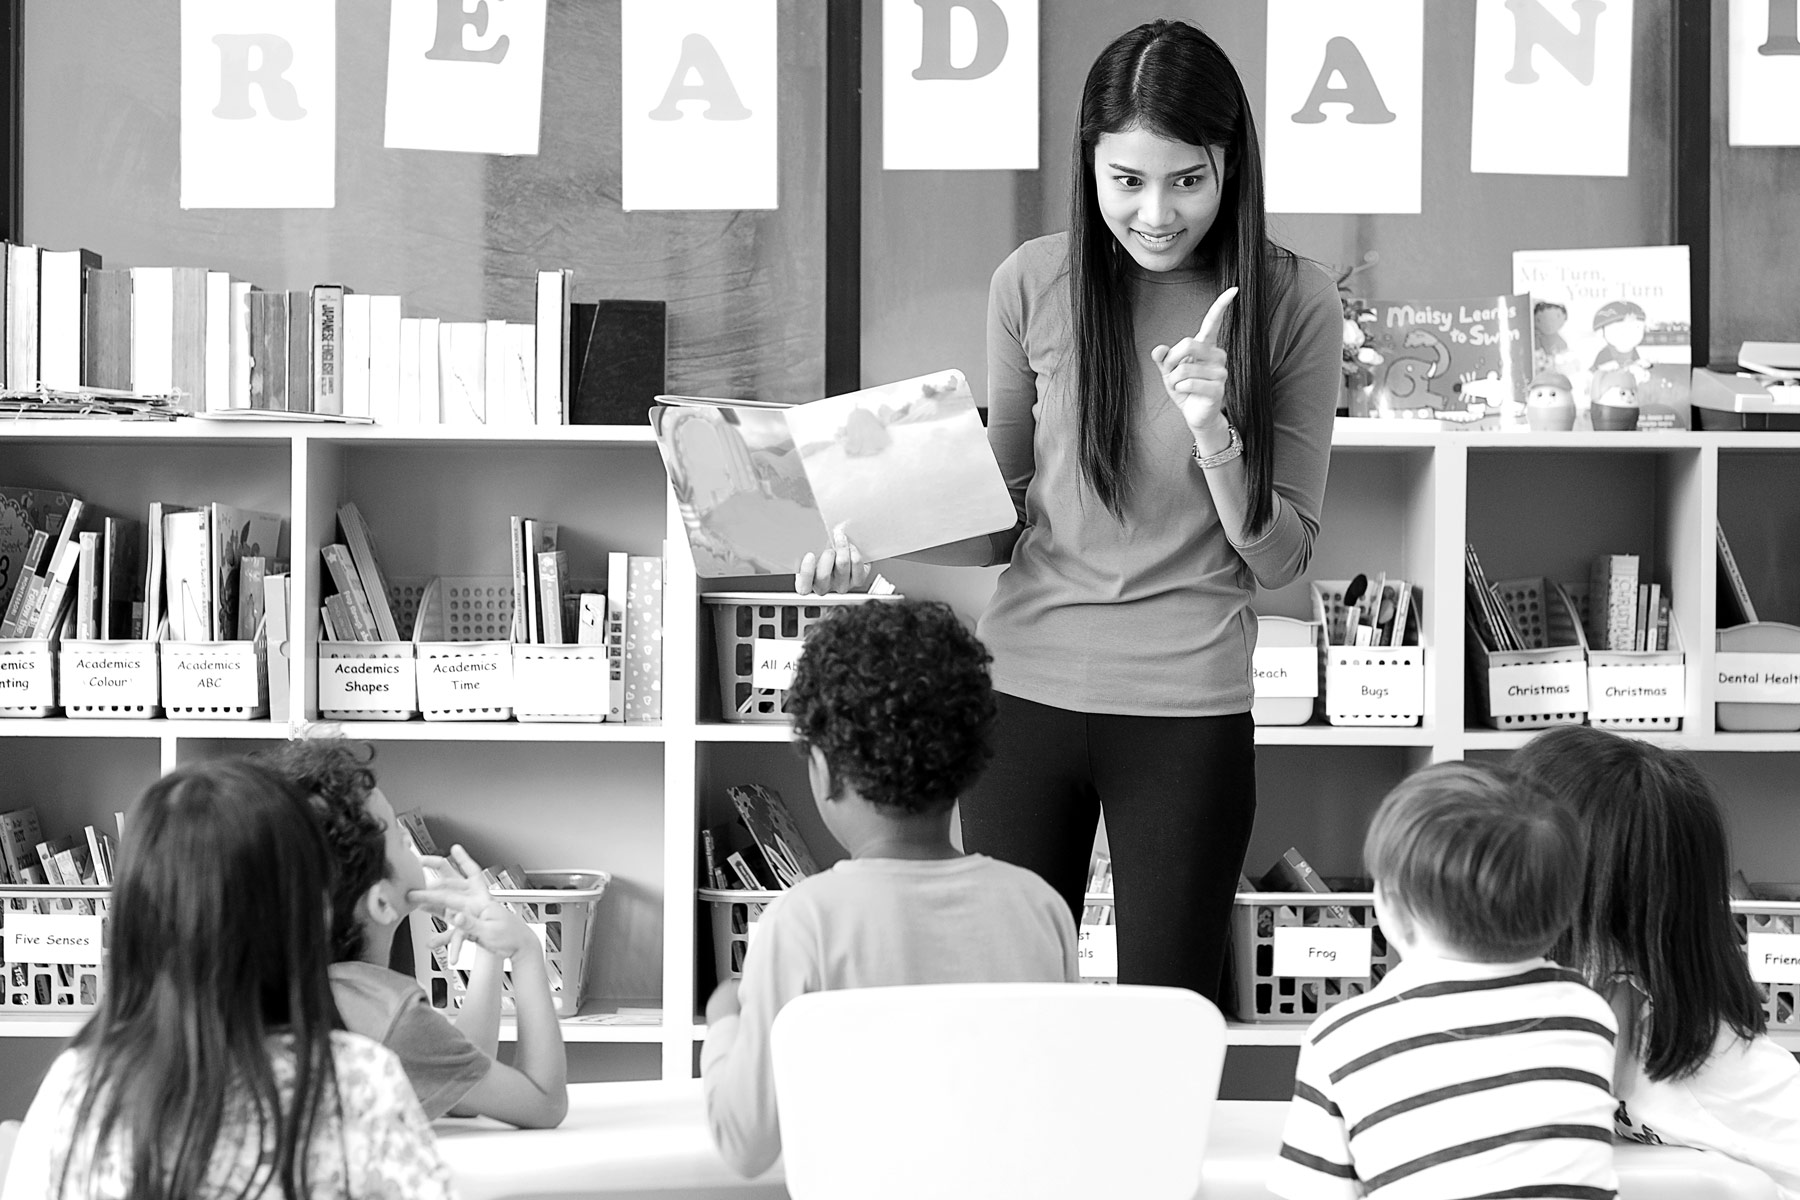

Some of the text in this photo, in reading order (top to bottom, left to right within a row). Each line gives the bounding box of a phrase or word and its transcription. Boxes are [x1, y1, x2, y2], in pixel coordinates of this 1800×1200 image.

[1565, 281, 1664, 301] Your Turn
[1386, 305, 1517, 332] Maisy Lears
[1449, 328, 1467, 344] to
[20, 587, 39, 619] Follow
[76, 658, 141, 669] Academics
[177, 659, 241, 671] Academics
[334, 662, 400, 674] Academics
[433, 661, 497, 674] Academics
[760, 659, 777, 670] All
[88, 676, 128, 688] Colour
[197, 677, 224, 689] ABC
[450, 679, 481, 691] Time
[1718, 672, 1800, 685] Dental Healt
[344, 680, 390, 696] Shapes
[1361, 684, 1390, 700] Bugs
[1507, 683, 1571, 697] Christmas
[1605, 685, 1668, 698] Christmas
[15, 933, 90, 946] Five Senses
[1308, 946, 1337, 962] Frog
